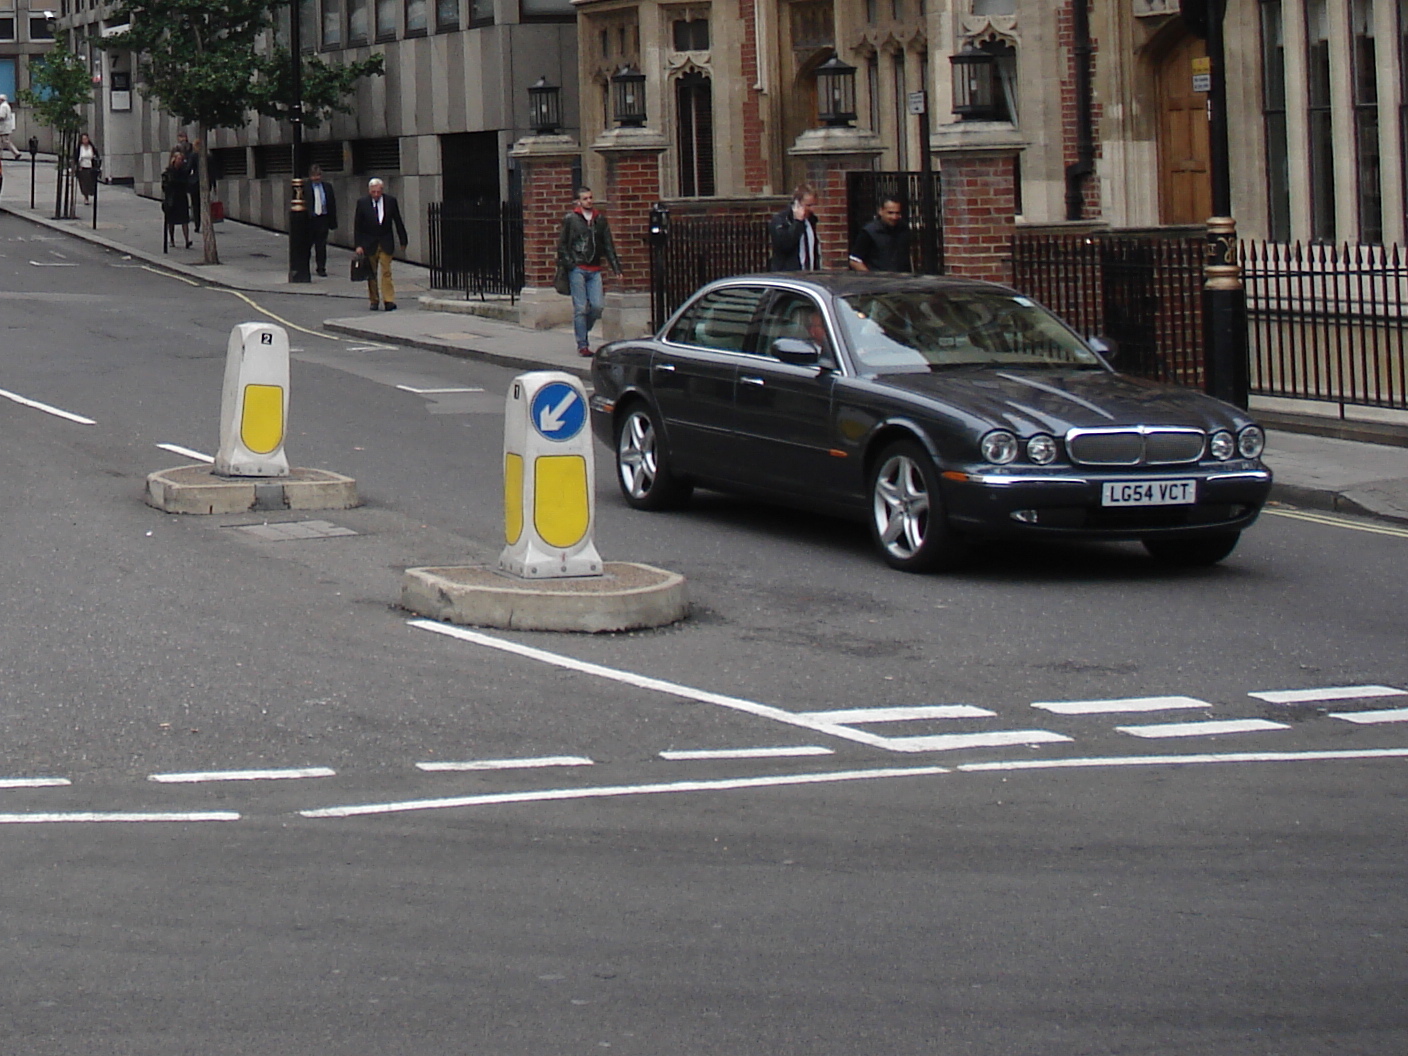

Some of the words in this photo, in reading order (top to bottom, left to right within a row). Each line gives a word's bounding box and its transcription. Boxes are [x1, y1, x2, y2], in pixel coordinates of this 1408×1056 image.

[111, 55, 119, 68] 7
[263, 333, 271, 345] 2
[1110, 484, 1153, 503] LG54
[1159, 483, 1190, 501] VCT
